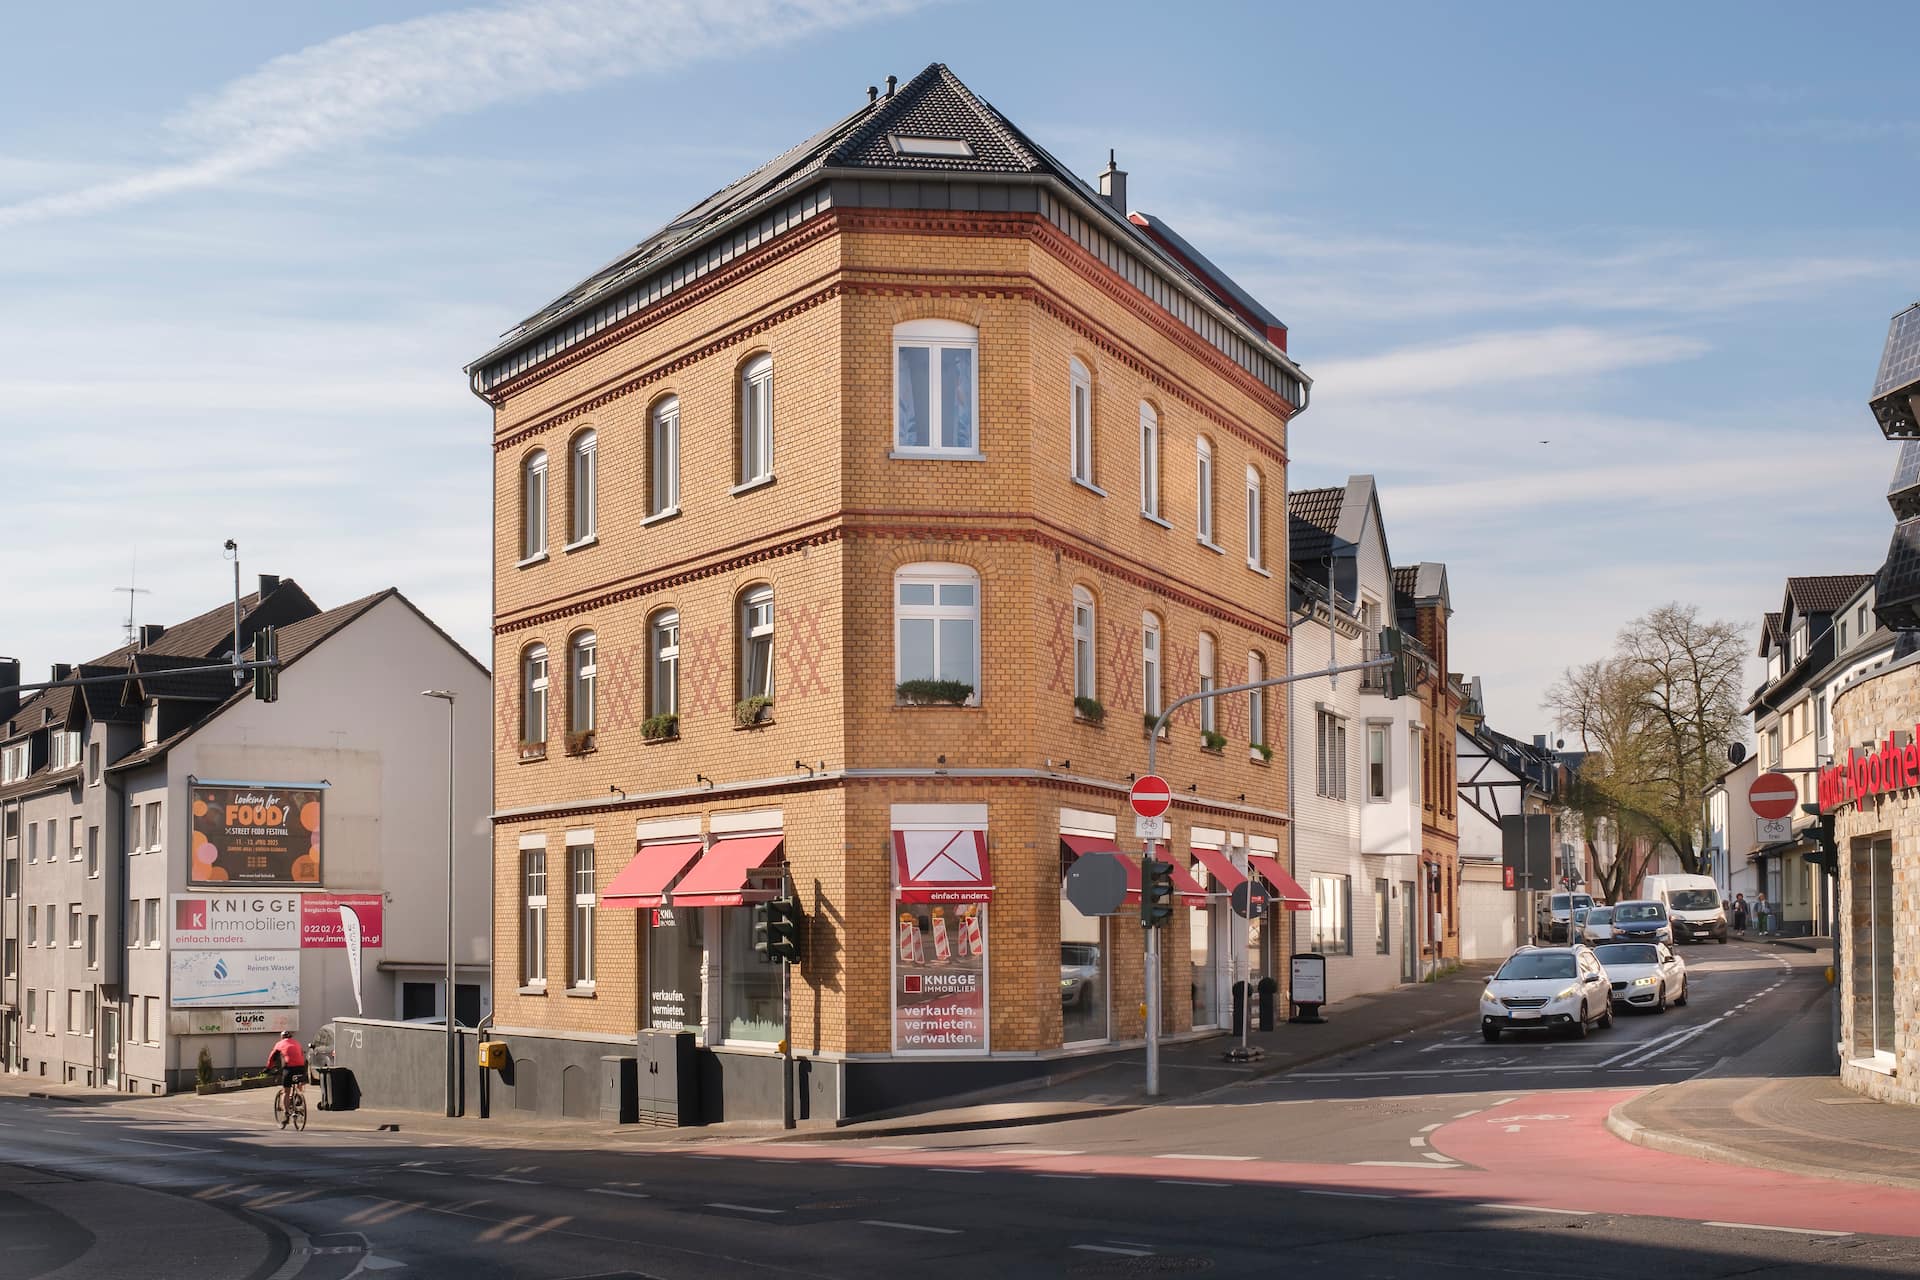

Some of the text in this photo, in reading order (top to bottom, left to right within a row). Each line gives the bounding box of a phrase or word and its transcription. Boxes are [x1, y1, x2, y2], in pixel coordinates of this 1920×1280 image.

[234, 793, 281, 813] Looking for
[231, 827, 288, 836] STREET FOOD FESTIVAL
[931, 892, 990, 900] einfach anders.
[211, 899, 296, 913] KNIGGE
[210, 917, 296, 932] Immobilien
[175, 935, 210, 943] einfach
[270, 963, 296, 971] Wasser
[924, 975, 976, 985] KNIGGE
[652, 988, 686, 1002] verkaufen.
[924, 985, 976, 993] IMMOBILIEN
[652, 1003, 686, 1017] vermieten.
[904, 1004, 977, 1016] verkaufen.
[904, 1018, 977, 1030] vermieten.
[343, 1028, 363, 1048] 79
[904, 1032, 977, 1044] verwalten.
